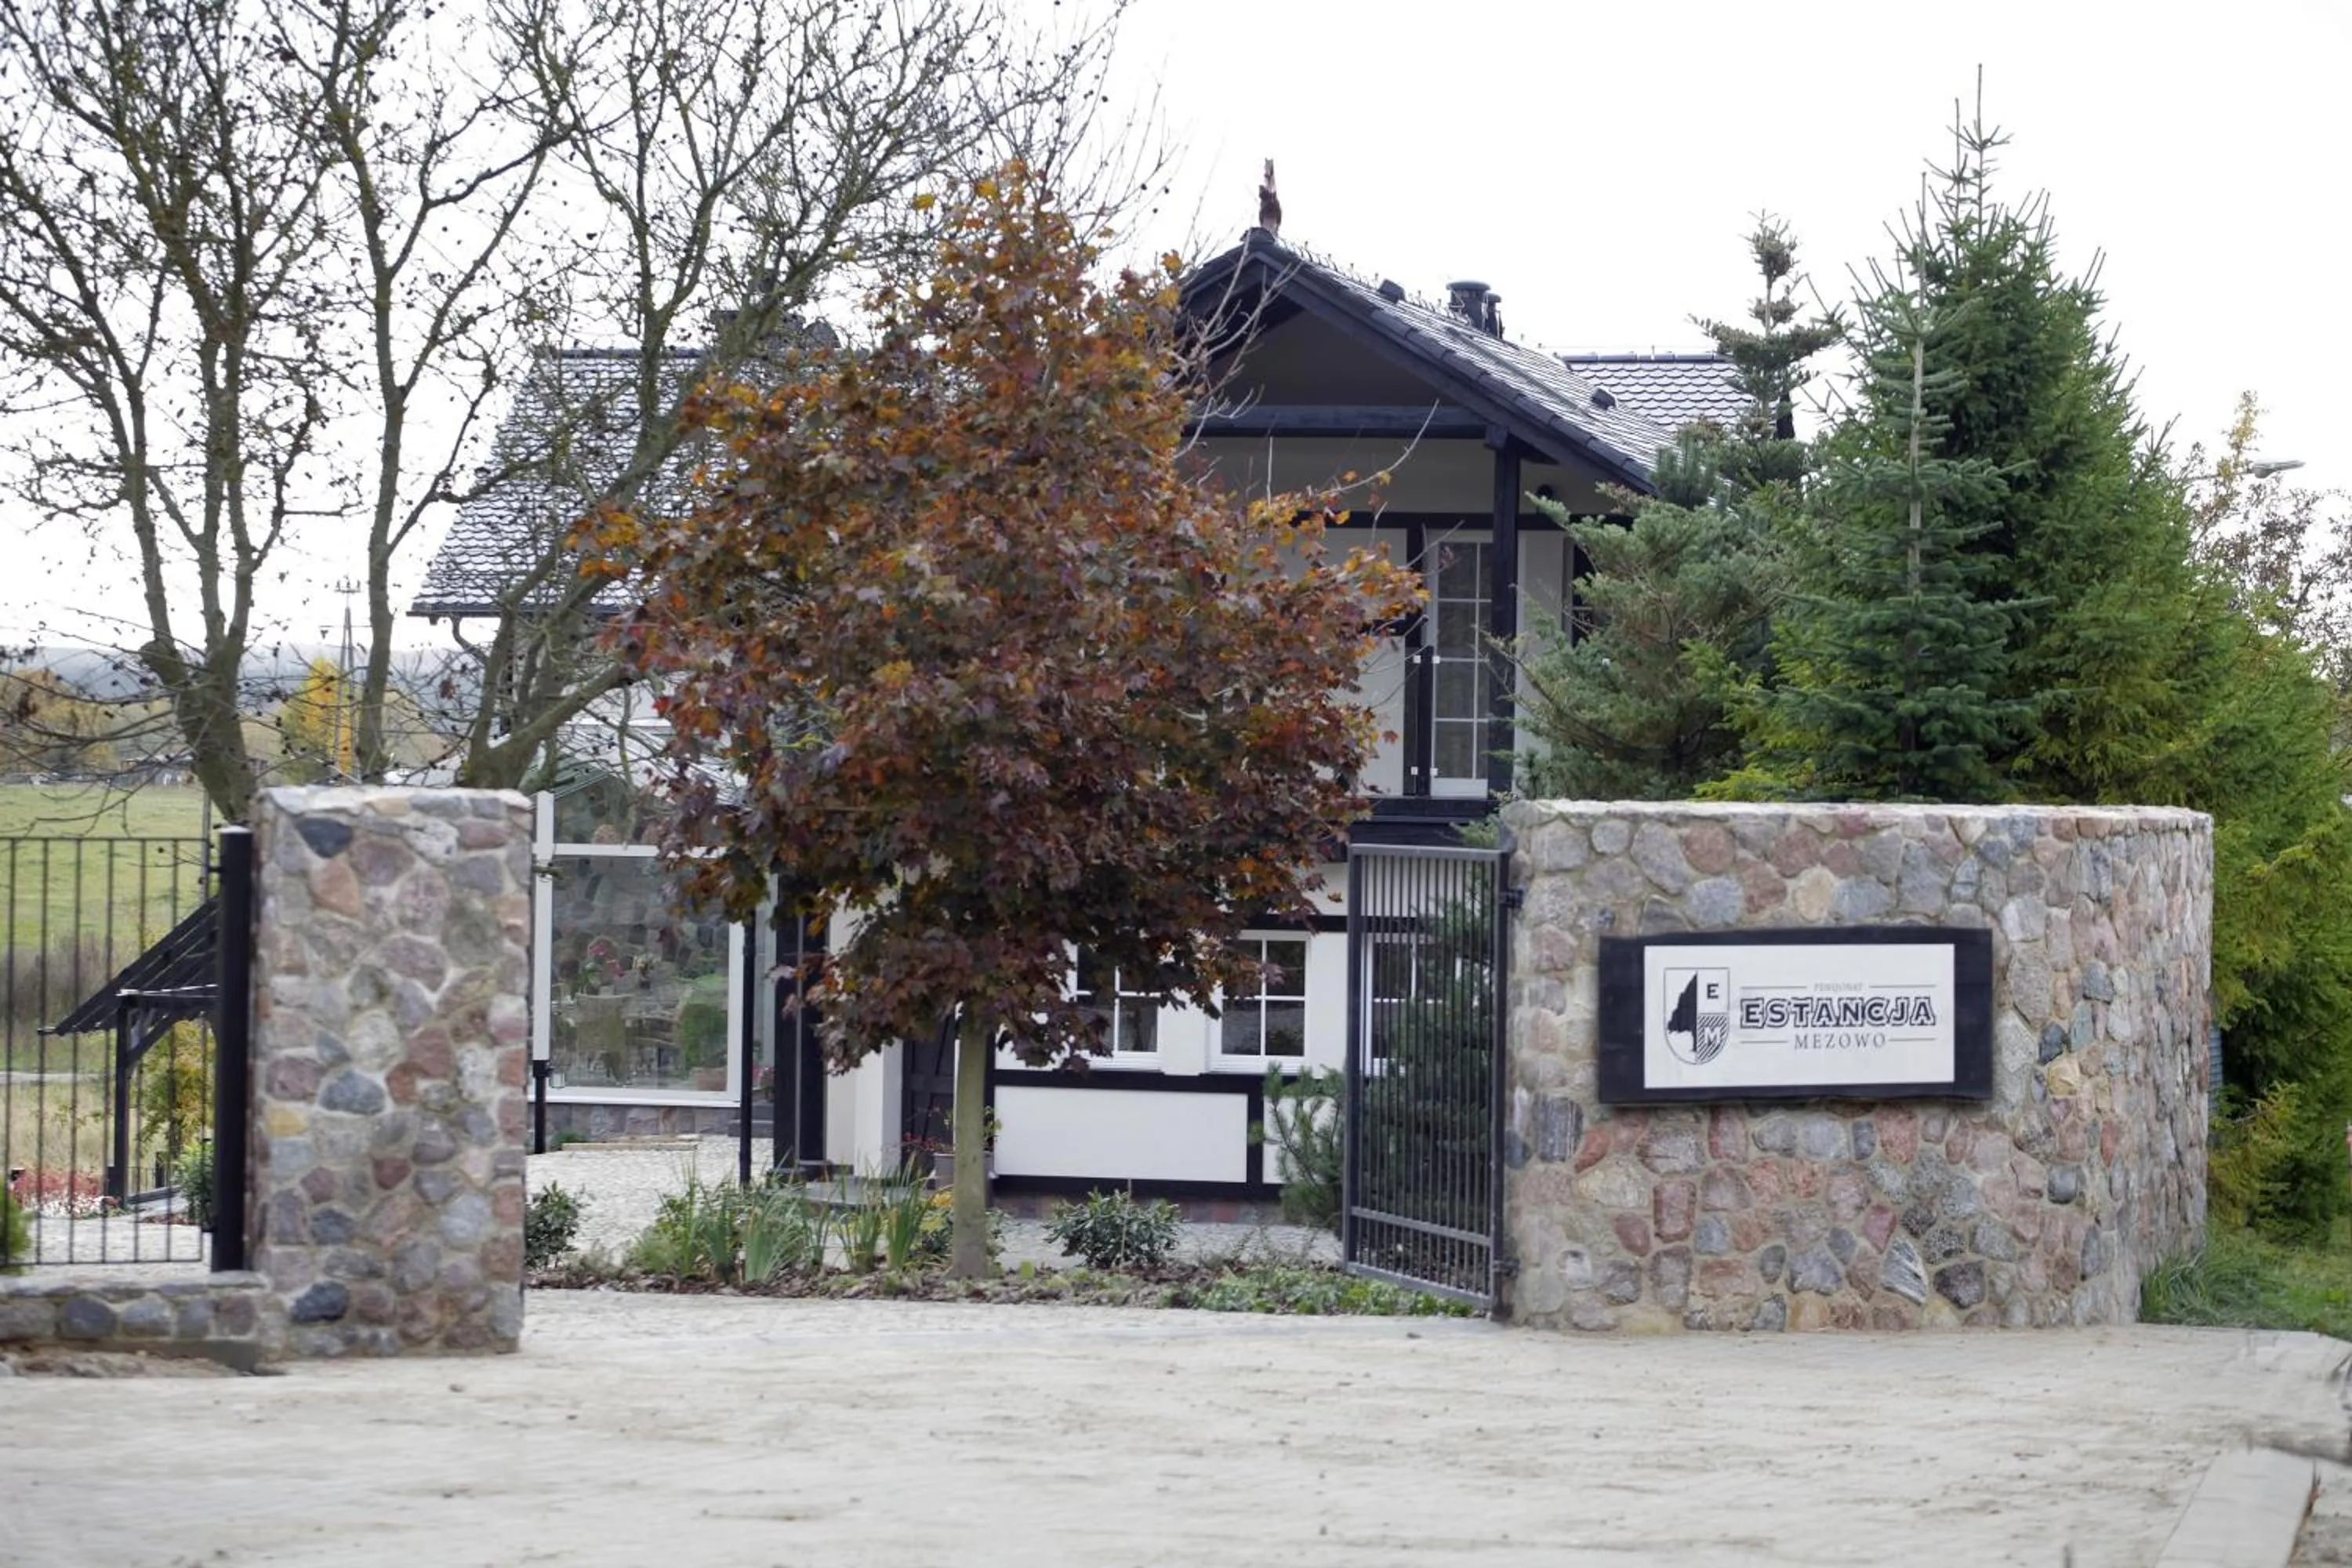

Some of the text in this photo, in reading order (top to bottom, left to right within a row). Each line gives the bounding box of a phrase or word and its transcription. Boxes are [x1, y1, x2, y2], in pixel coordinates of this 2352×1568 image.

[1708, 983, 1719, 999] E
[1740, 996, 1936, 1029] ESTANCJA
[1704, 1026, 1721, 1044] M
[1795, 1033, 1886, 1050] MEZOWO
